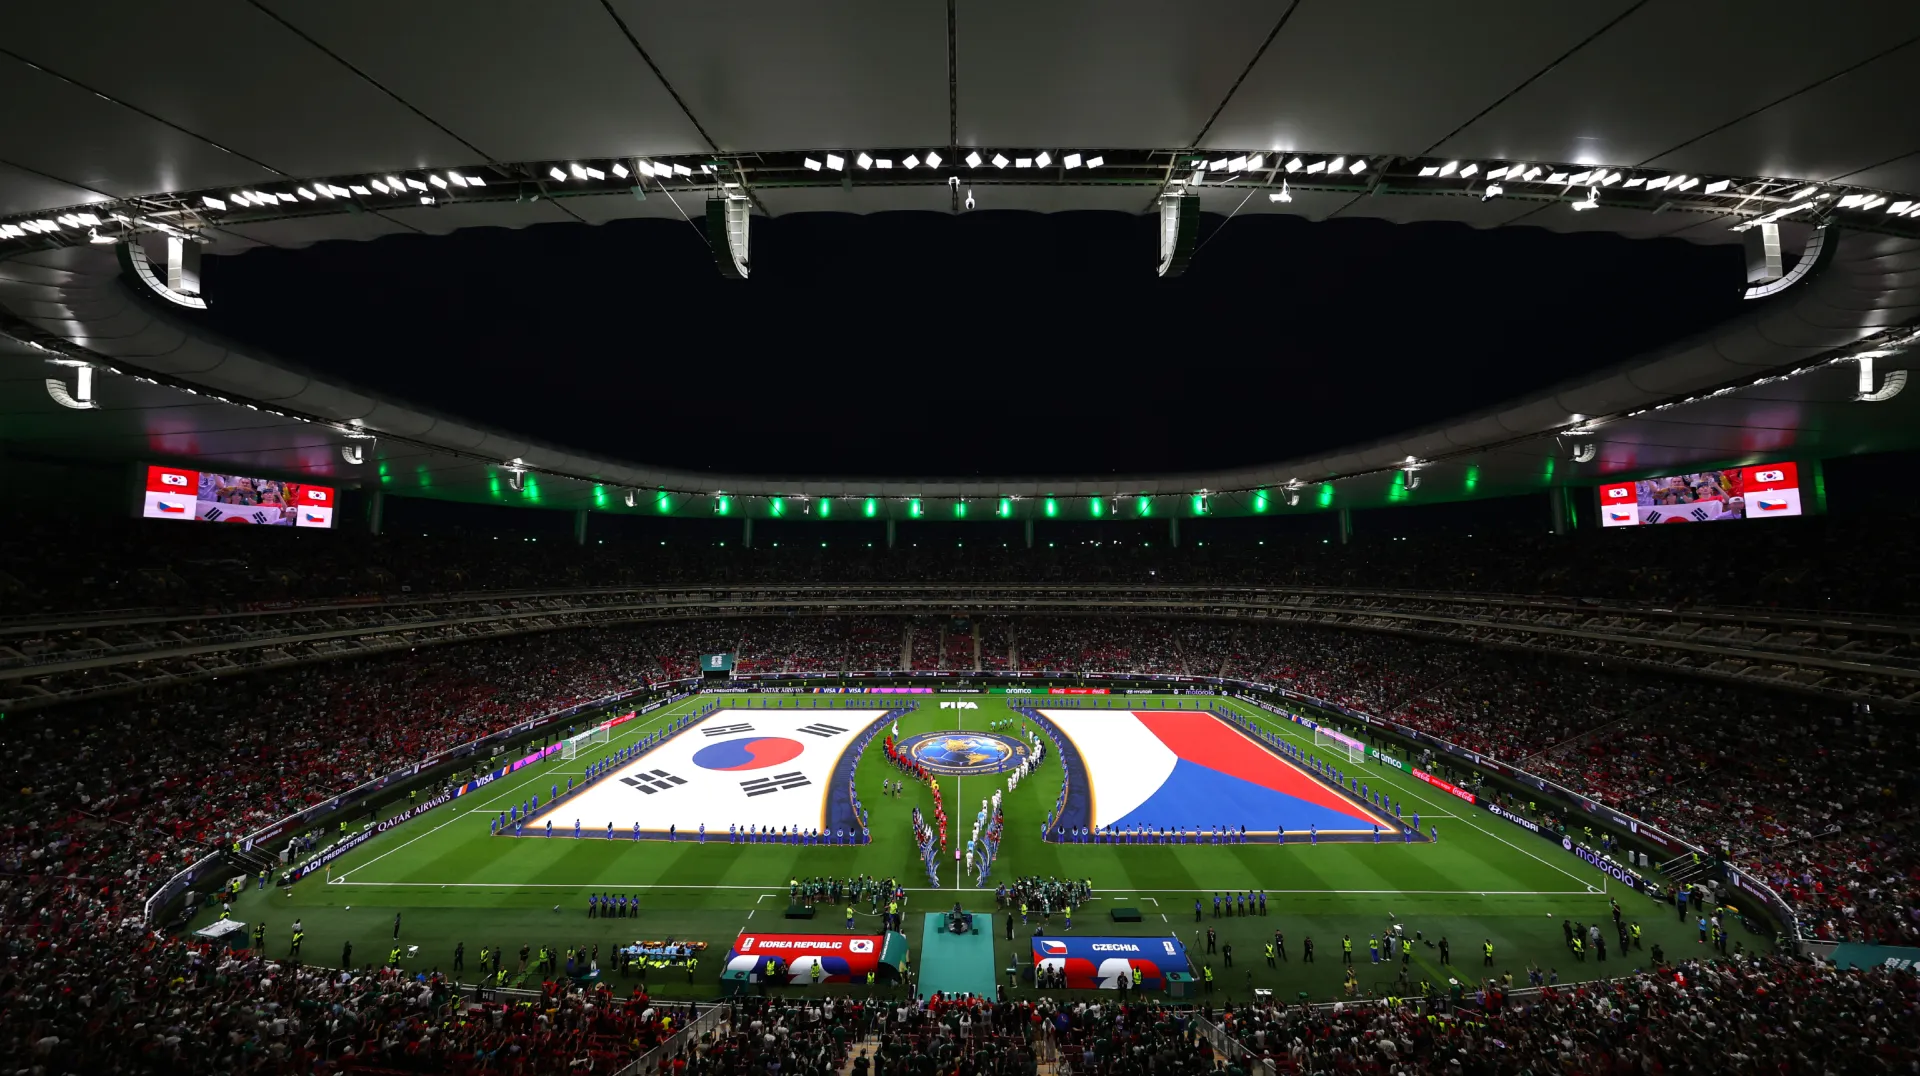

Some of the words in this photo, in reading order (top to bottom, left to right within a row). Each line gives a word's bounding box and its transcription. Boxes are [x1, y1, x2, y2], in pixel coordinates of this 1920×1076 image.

[1301, 719, 1312, 728] VISA
[476, 773, 494, 787] VISA
[378, 811, 411, 832] QATAR
[414, 793, 451, 815] AIRWAYS
[1502, 810, 1539, 833] HYUNDAI
[302, 859, 321, 876] ADI
[322, 830, 372, 864] PREDICTSTREET
[1575, 847, 1634, 888] motorola
[758, 940, 792, 949] KOREA
[793, 940, 842, 949] REPUBLIC
[1092, 943, 1140, 952] CZECHIA
